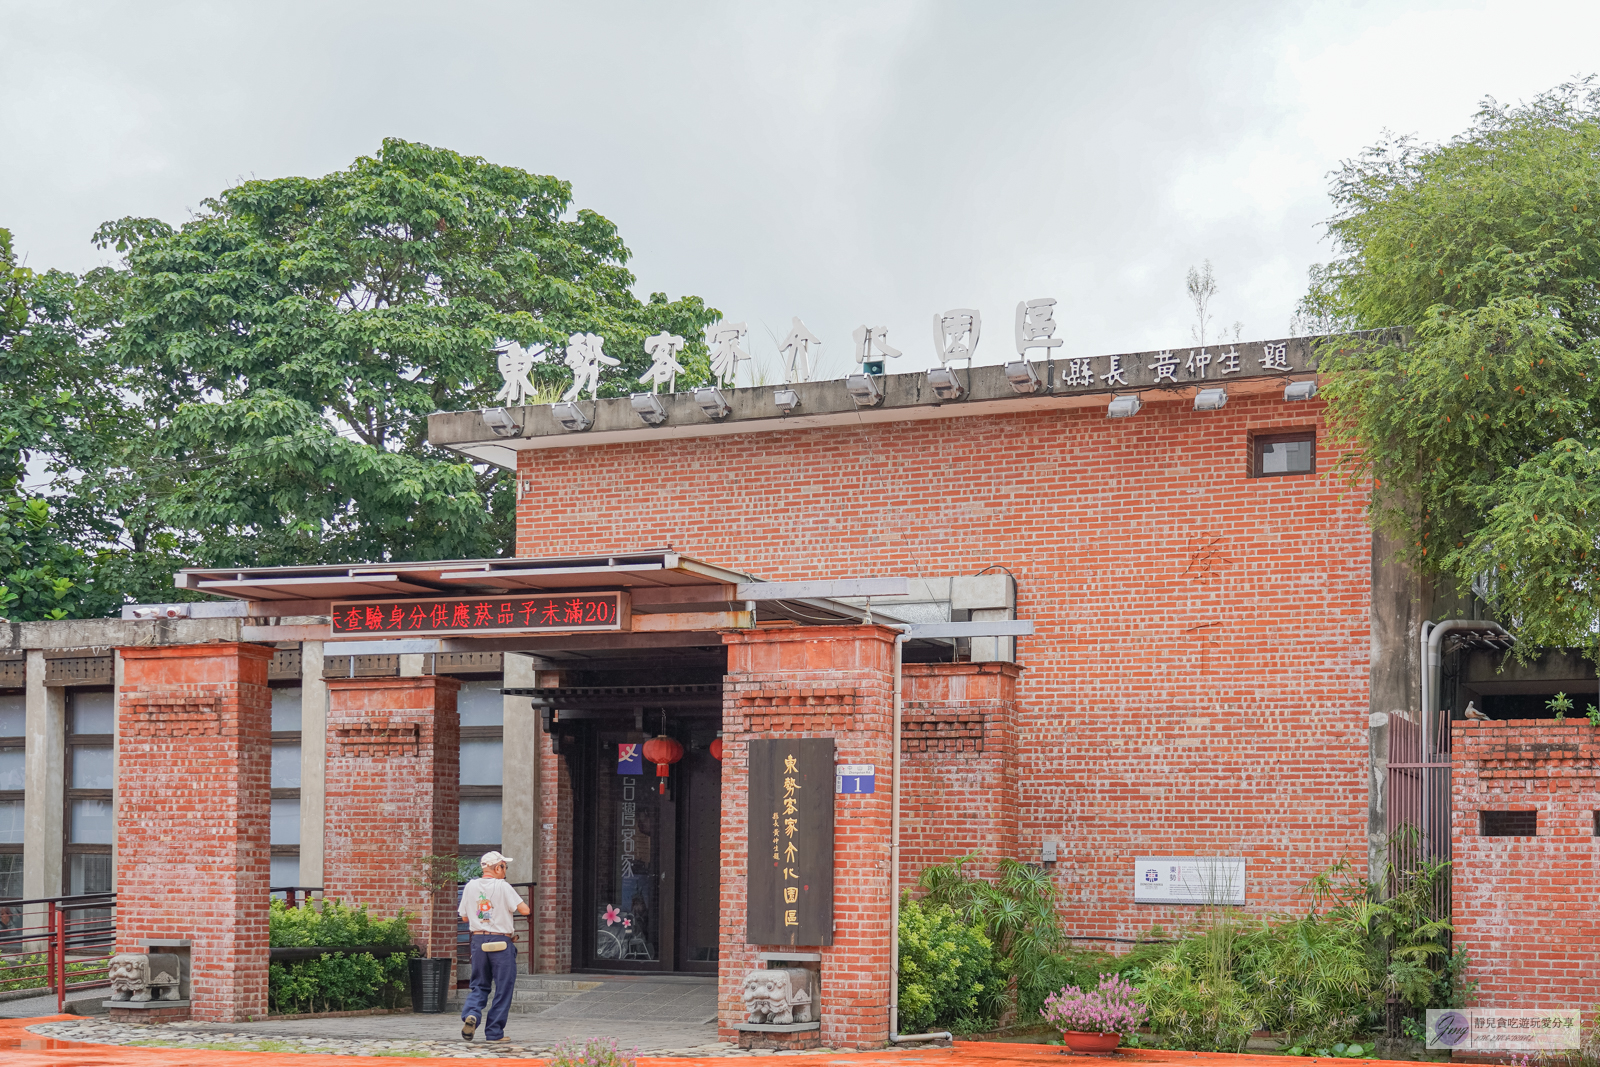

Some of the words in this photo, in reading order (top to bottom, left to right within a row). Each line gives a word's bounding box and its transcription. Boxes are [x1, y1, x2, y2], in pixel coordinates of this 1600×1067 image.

[496, 297, 1064, 403] 東勢客家文化園區
[854, 777, 862, 792] 1
[782, 754, 802, 927] 東勢客家文化園區
